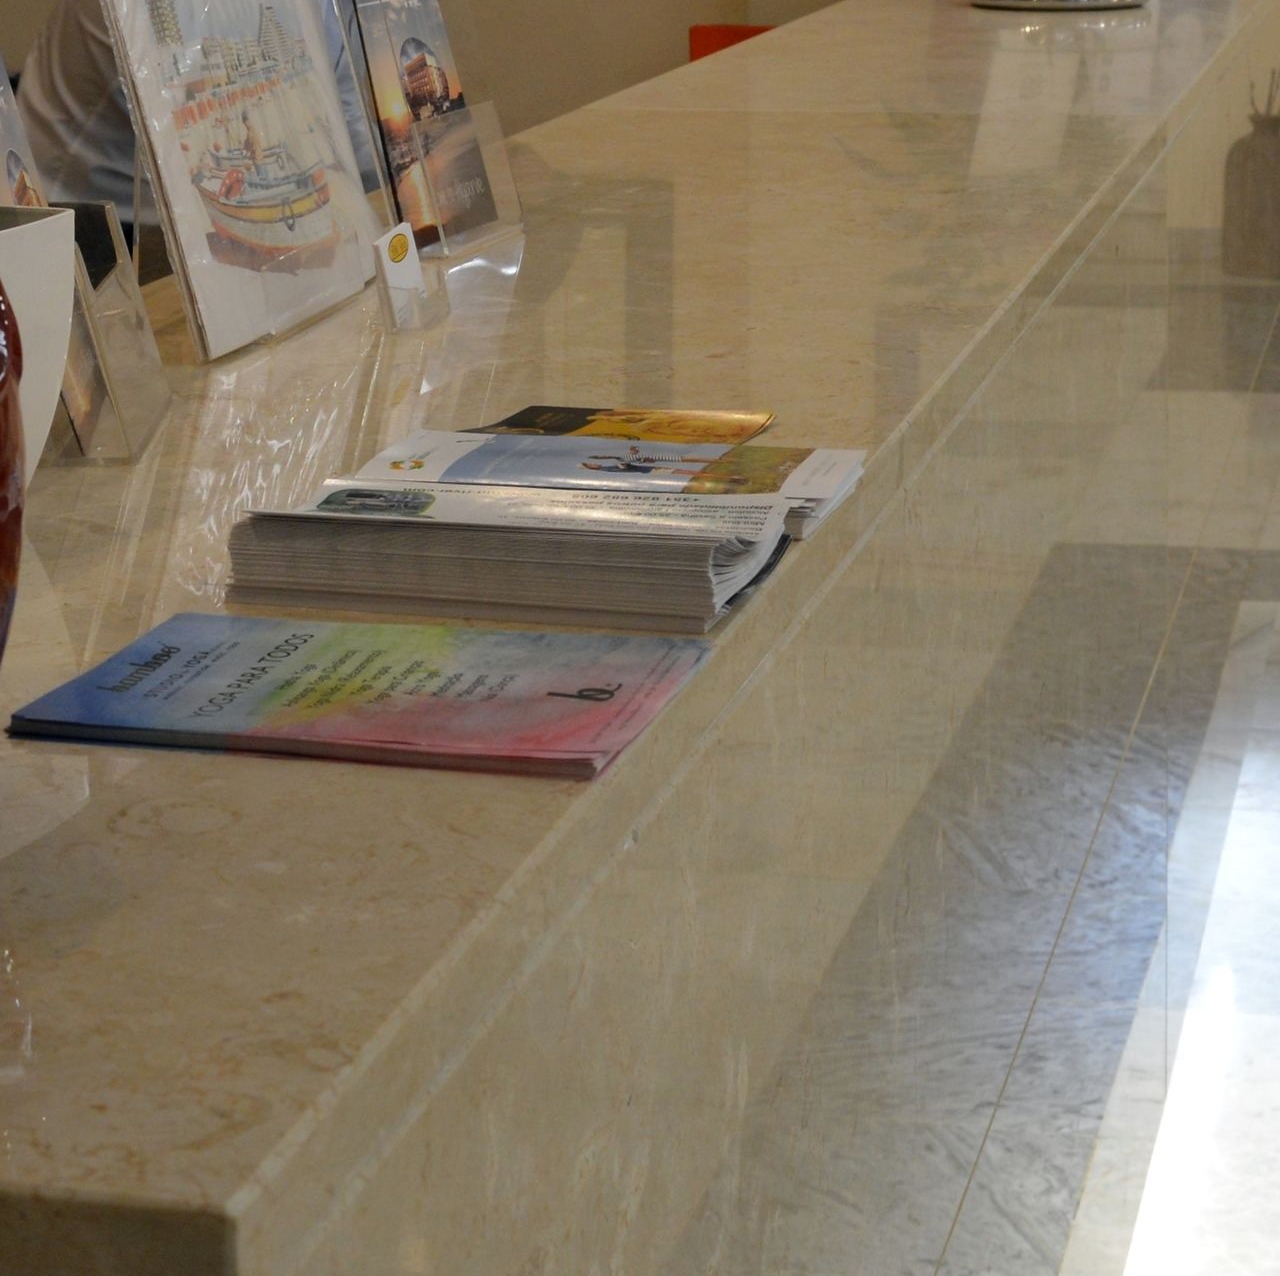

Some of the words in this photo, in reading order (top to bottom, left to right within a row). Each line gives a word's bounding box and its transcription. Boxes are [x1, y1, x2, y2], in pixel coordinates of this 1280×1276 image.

[187, 690, 241, 718] YOGA
[227, 665, 272, 690] PARA
[257, 632, 315, 667] TODOS
